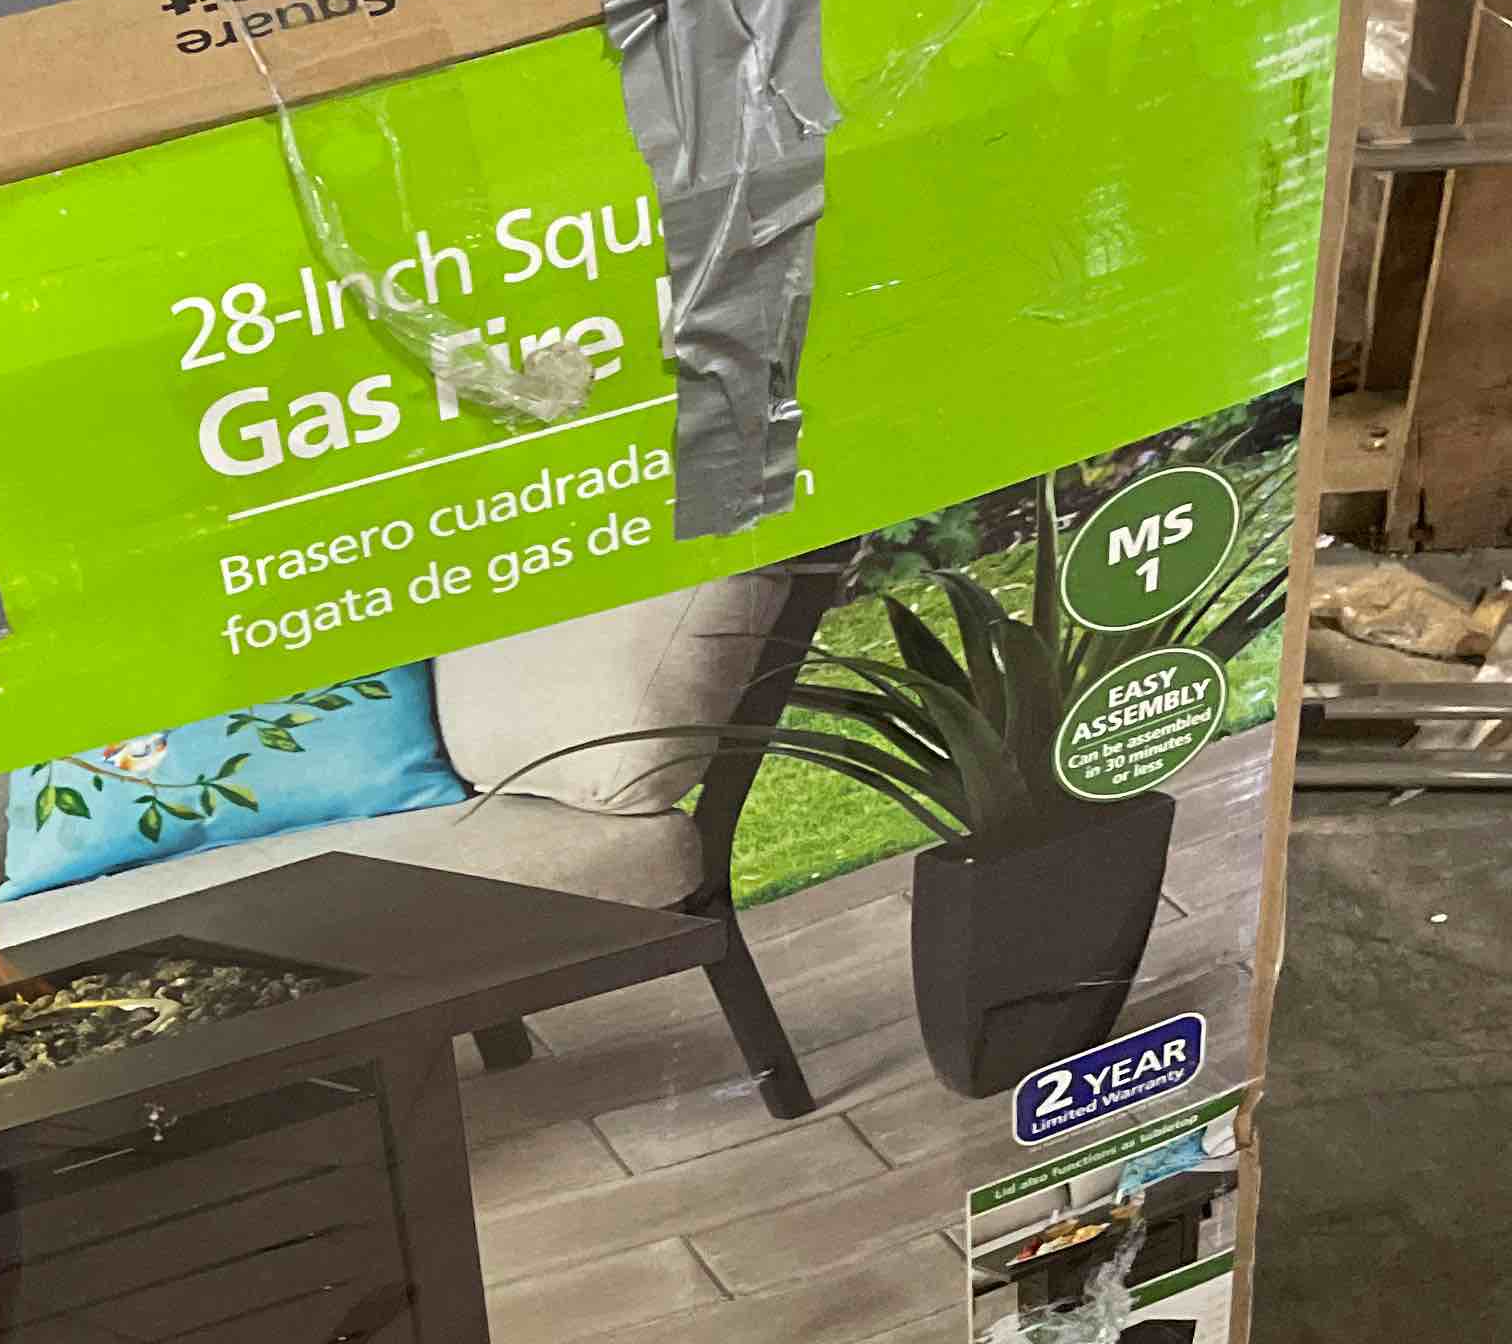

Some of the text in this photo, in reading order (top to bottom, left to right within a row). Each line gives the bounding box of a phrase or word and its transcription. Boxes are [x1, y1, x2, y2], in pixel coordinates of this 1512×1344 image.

[170, 195, 666, 371] 28-Inch Squ
[198, 372, 402, 477] Gas
[431, 311, 626, 423] Fire
[219, 443, 673, 597] Brasero cuadrada
[1107, 503, 1193, 566] MS
[222, 512, 653, 657] fogata de gas de
[1136, 557, 1160, 592] 1
[1072, 678, 1212, 745] ASSEMBLY
[1108, 666, 1177, 708] EASY
[1067, 707, 1210, 770] Can be assembled
[1084, 732, 1192, 780] in 30 minutes
[1112, 758, 1164, 785] or less
[1031, 1099, 1097, 1135] Limited
[1102, 1067, 1186, 1107] Warranty
[1035, 1038, 1187, 1118] 2 YEAR
[994, 1183, 1016, 1200] Lid
[1019, 1172, 1048, 1190] also
[1051, 1146, 1117, 1177] functions
[1121, 1140, 1136, 1152] as
